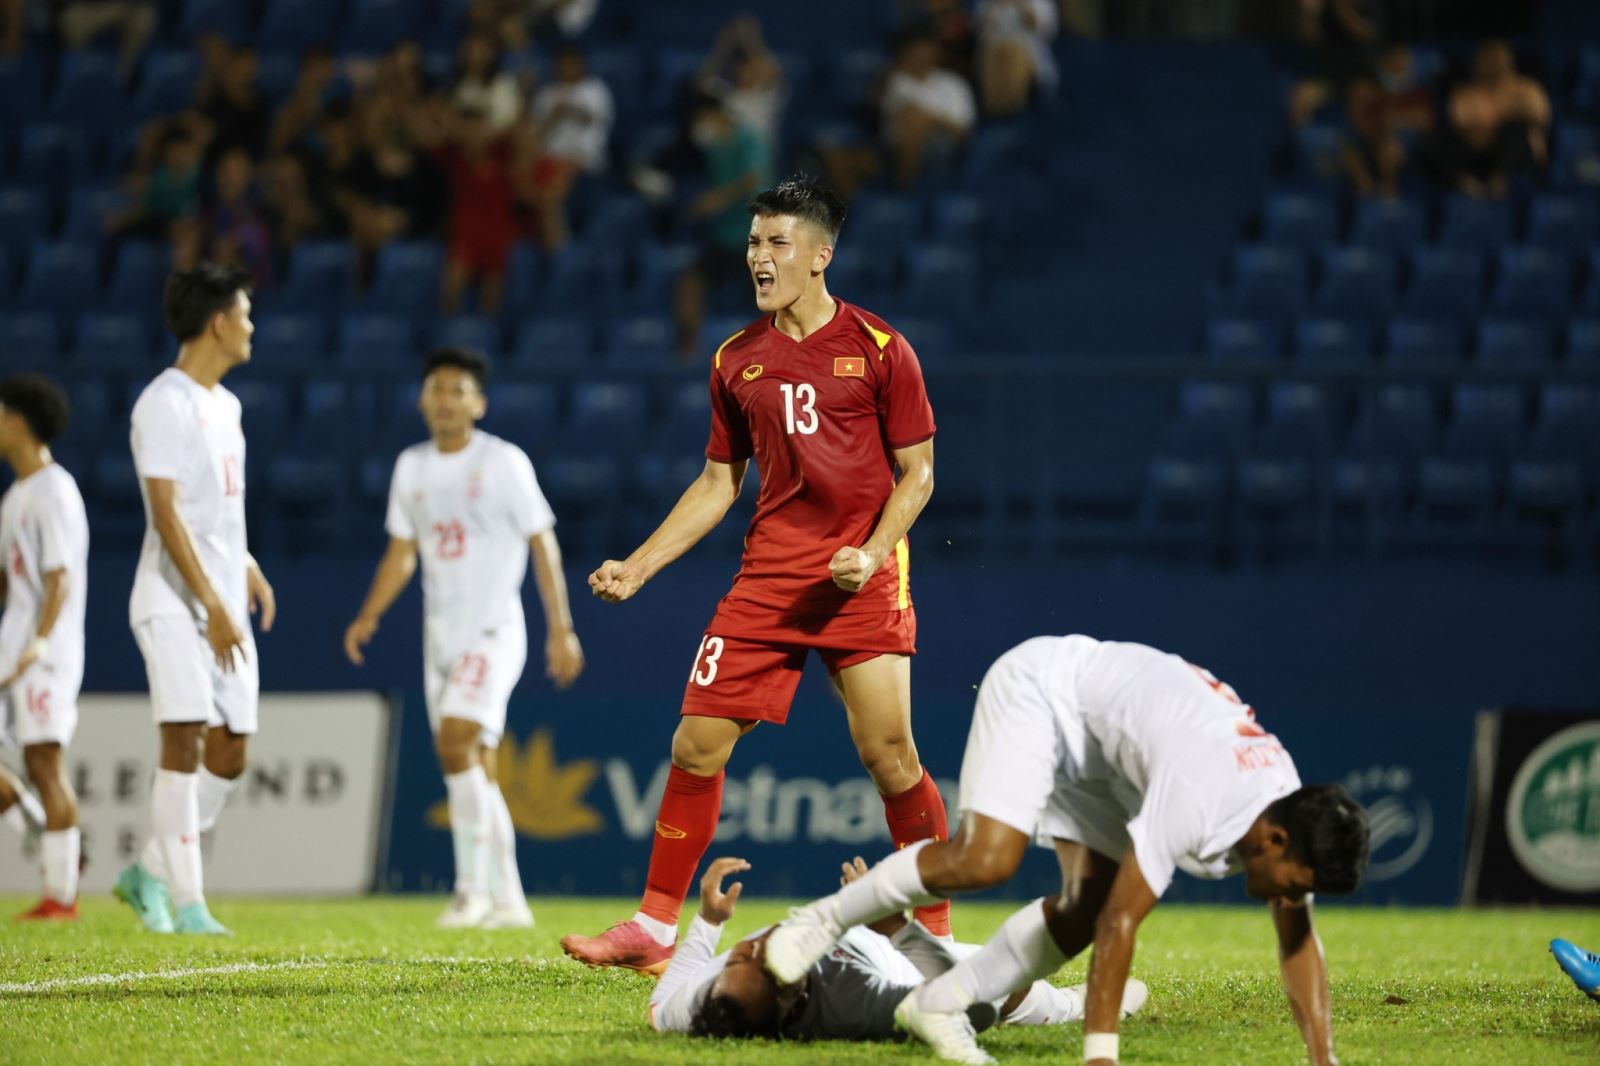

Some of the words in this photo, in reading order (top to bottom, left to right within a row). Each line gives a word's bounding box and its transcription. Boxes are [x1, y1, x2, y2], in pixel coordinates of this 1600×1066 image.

[780, 383, 819, 435] 13
[433, 519, 466, 560] 23
[689, 634, 724, 687] 13
[75, 757, 347, 807] LEND
